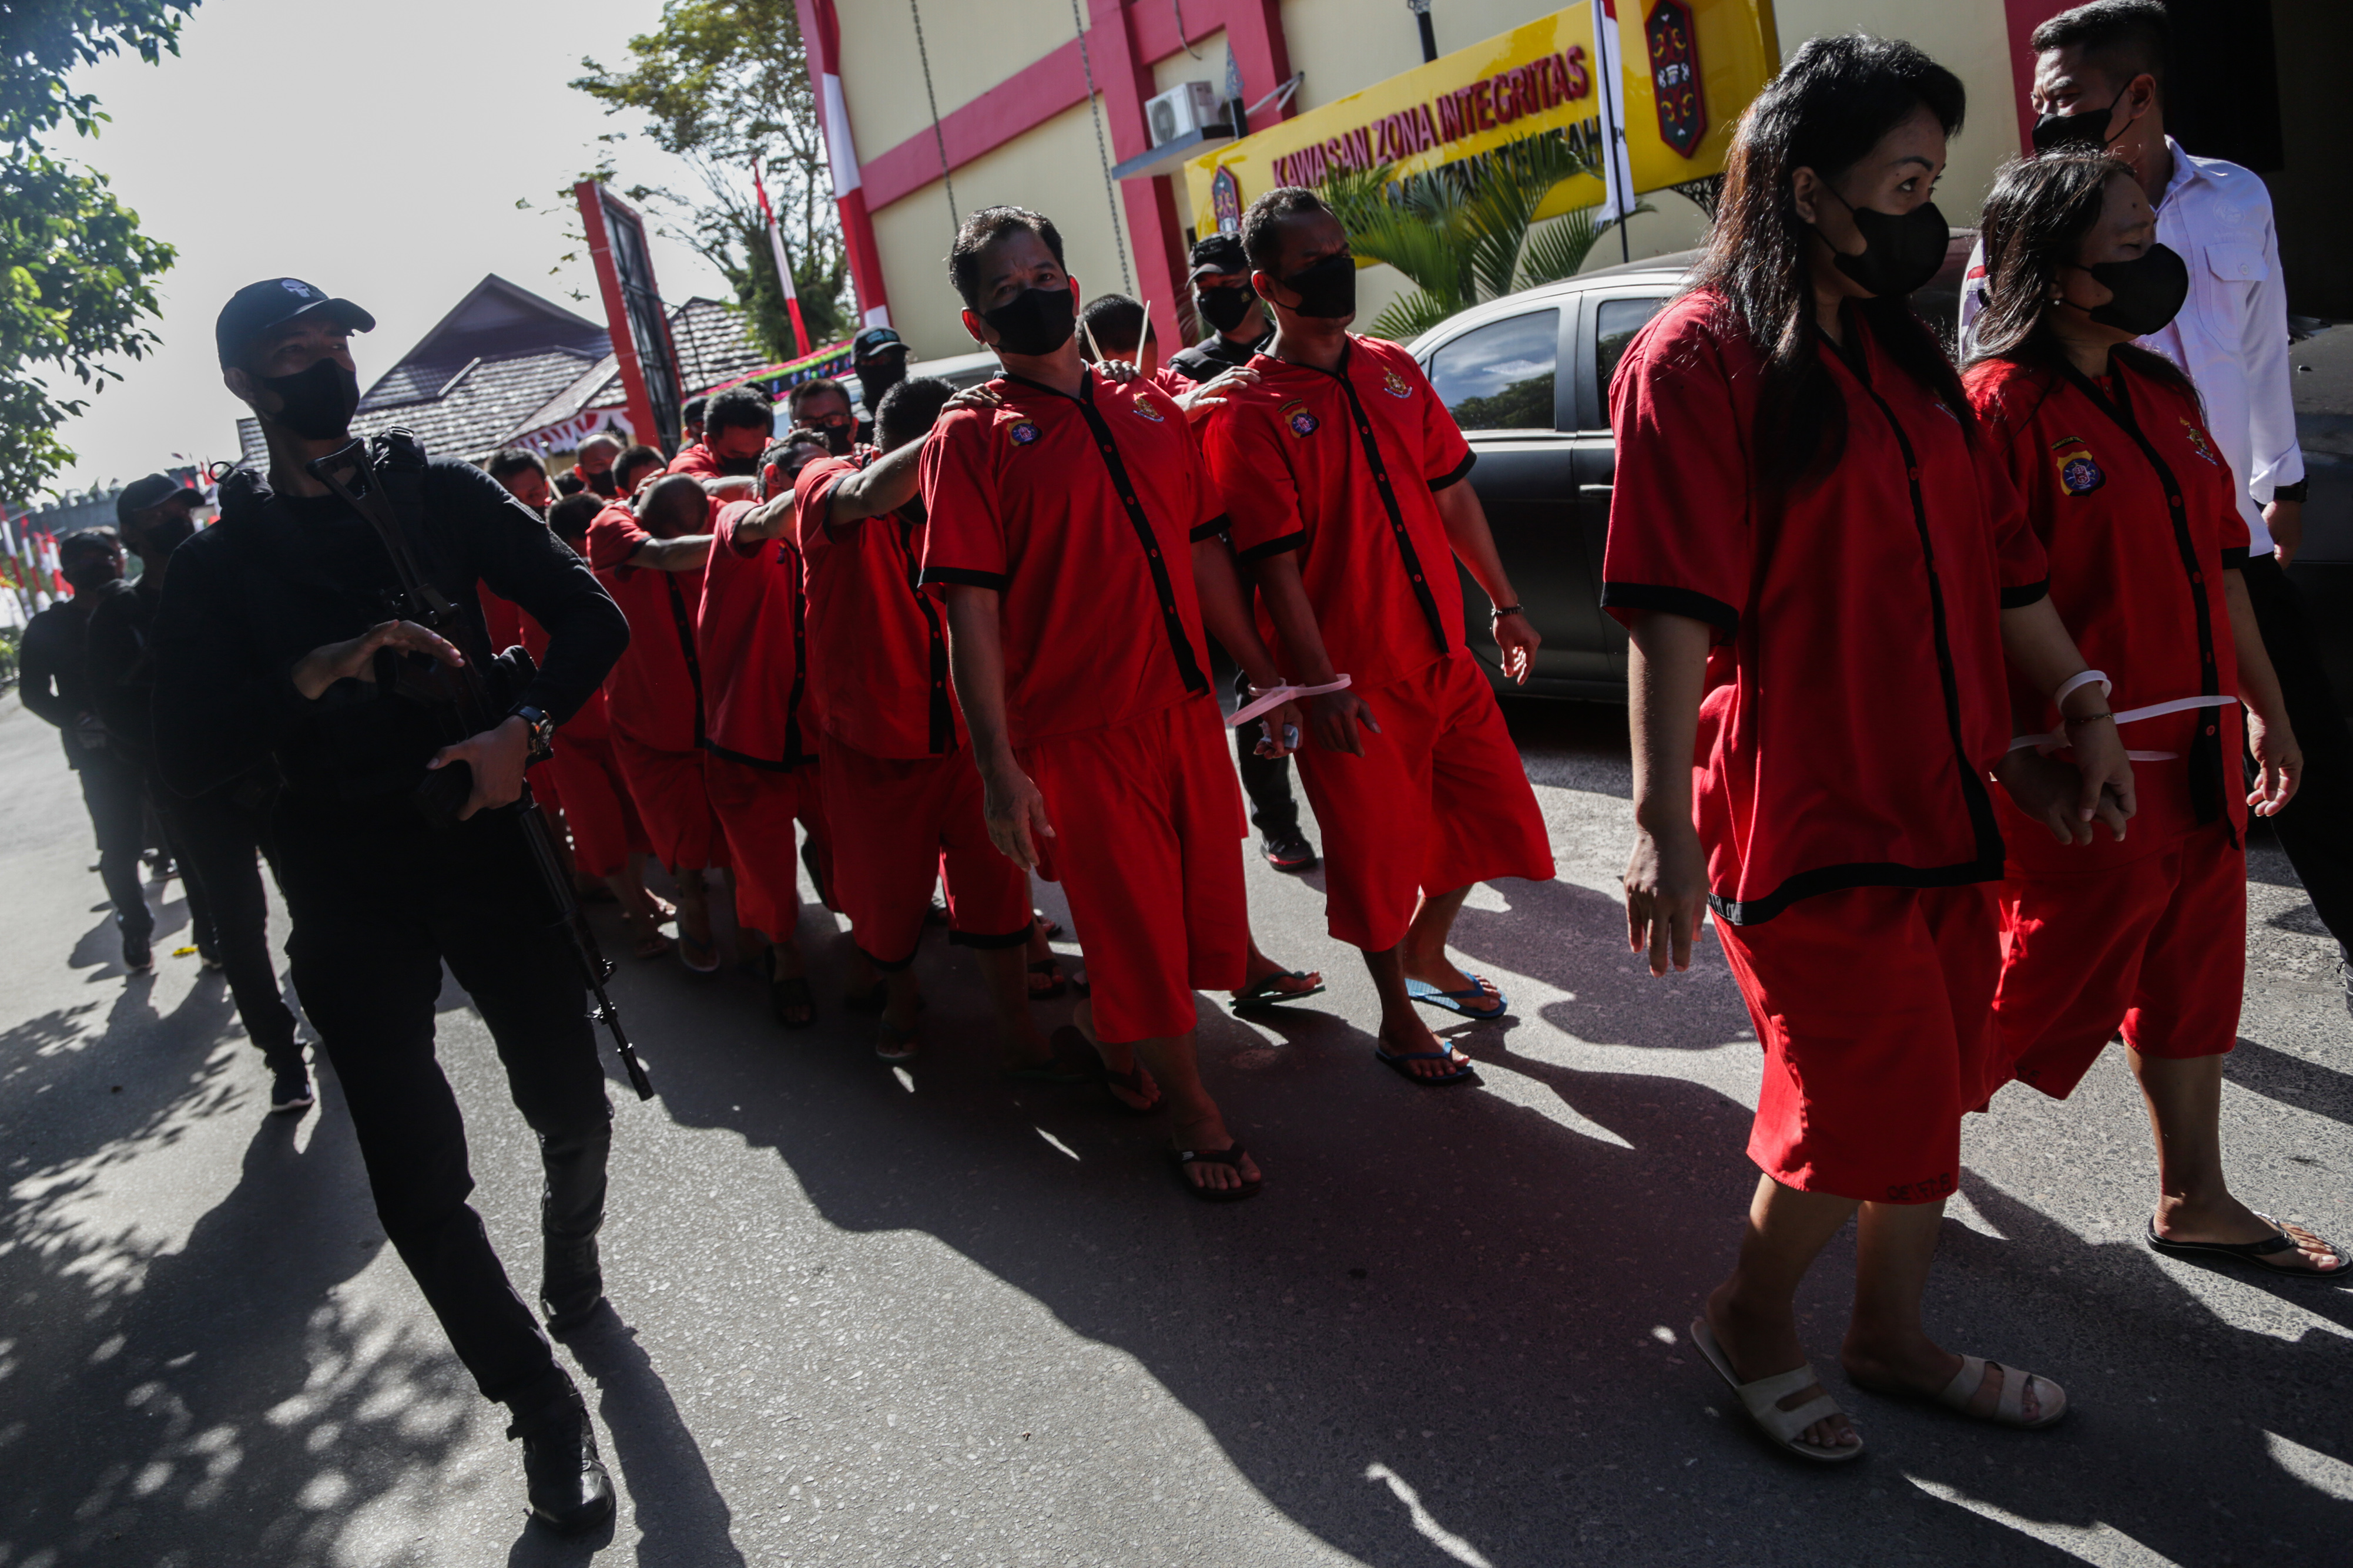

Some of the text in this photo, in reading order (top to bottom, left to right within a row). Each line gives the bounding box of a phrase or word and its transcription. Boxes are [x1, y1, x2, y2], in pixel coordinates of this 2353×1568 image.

[1272, 45, 1589, 188] KAWASAN ZONA INTEGRITAS
